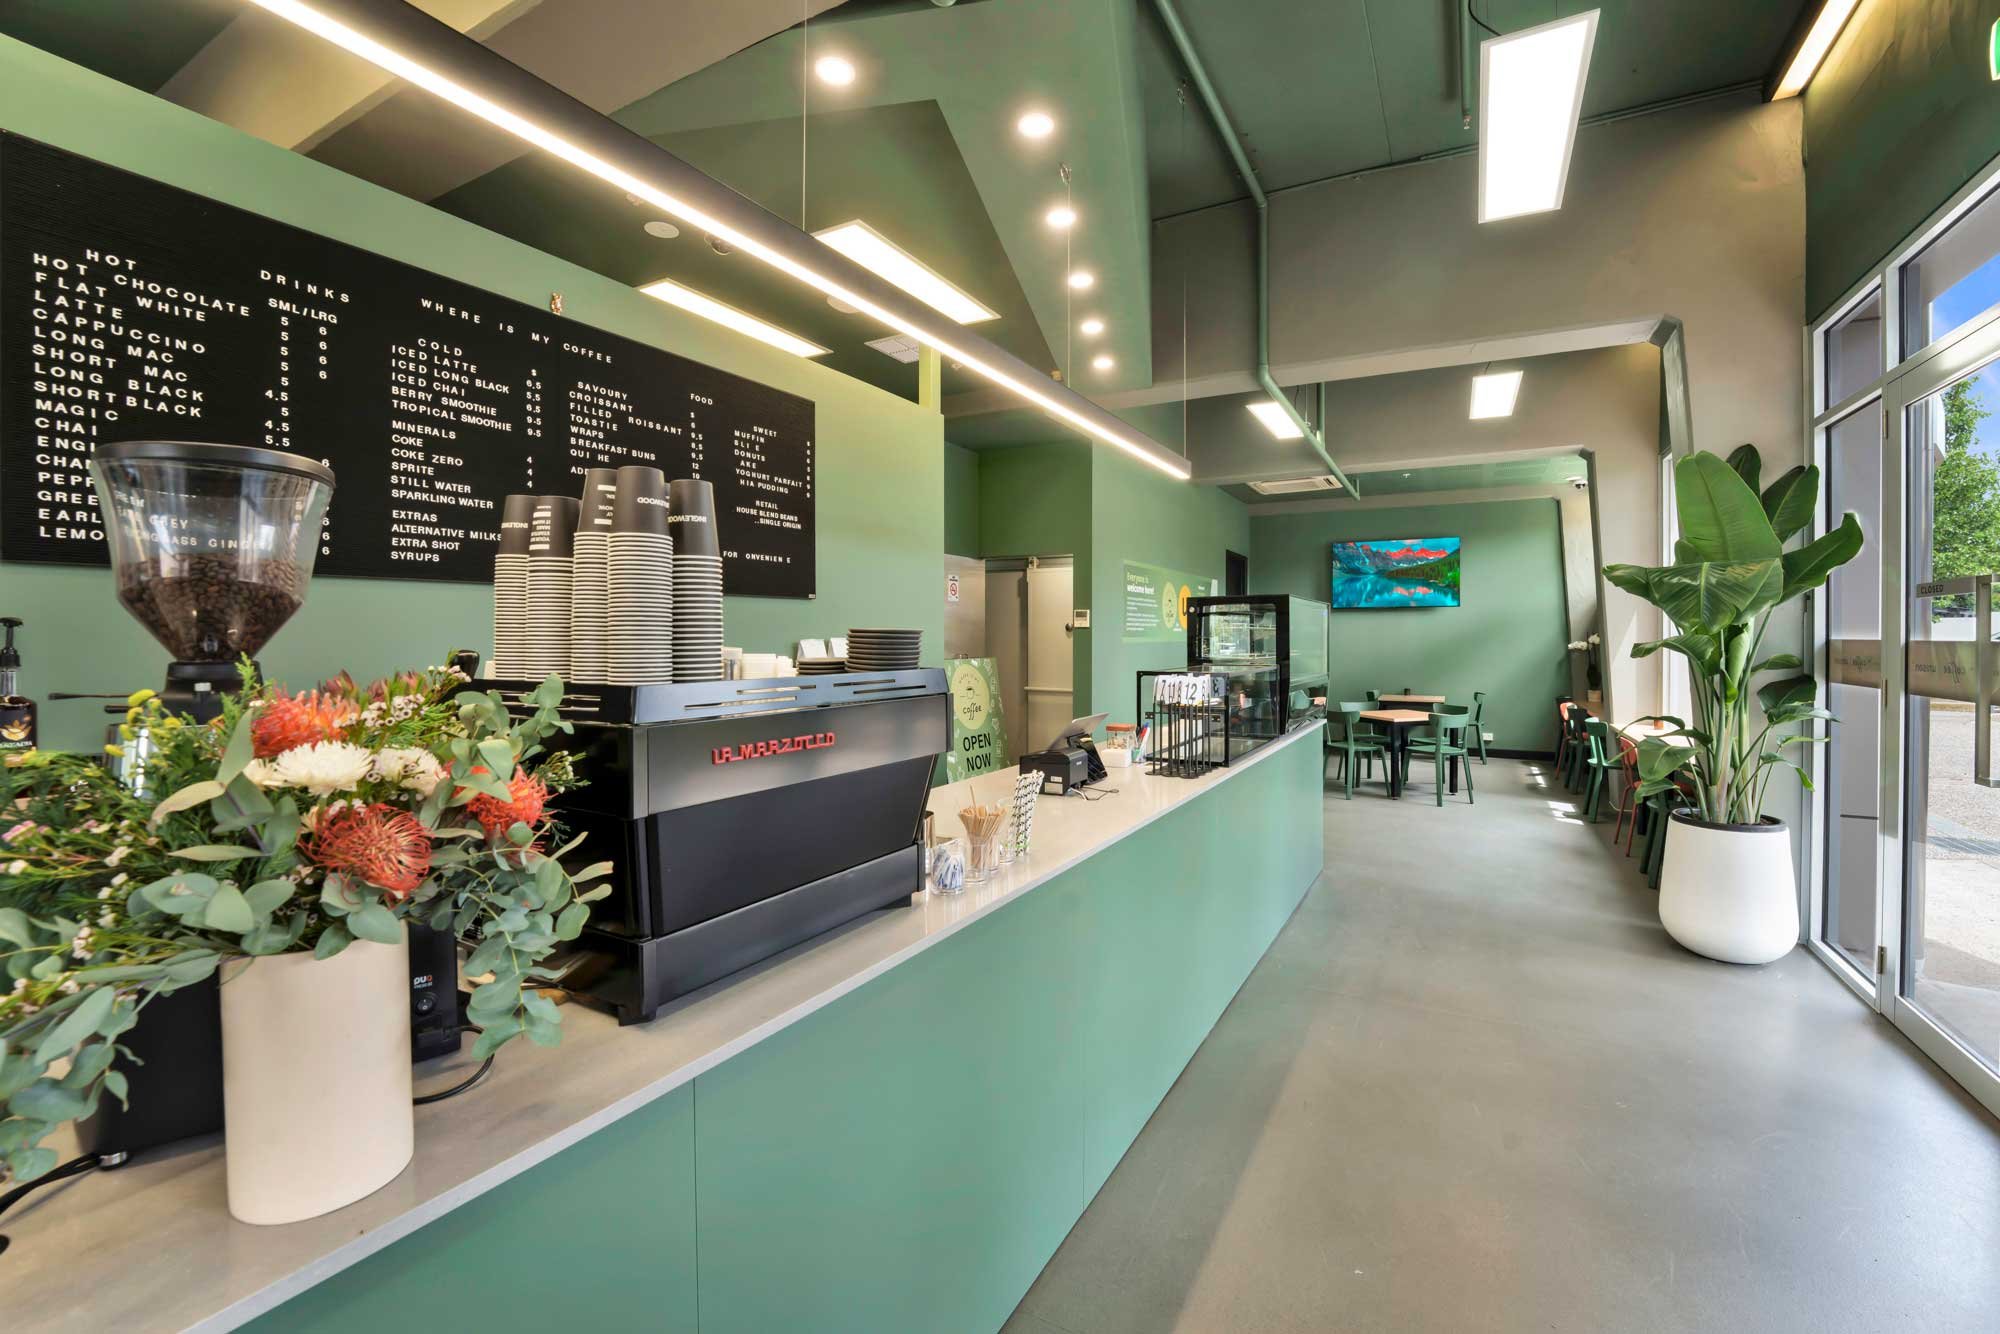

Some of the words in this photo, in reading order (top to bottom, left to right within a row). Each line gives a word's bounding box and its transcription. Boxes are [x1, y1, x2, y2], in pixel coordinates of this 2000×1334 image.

[86, 249, 136, 270] HOT
[33, 253, 88, 275] HOT
[114, 274, 249, 316] CHOCOLATE
[260, 270, 349, 303] DRINKS
[35, 272, 107, 297] FLAT
[136, 296, 205, 321] WHITE
[35, 290, 122, 319] LATTE
[268, 298, 337, 324] SML/LRG
[33, 308, 205, 353] CAPPUCCINO
[281, 316, 289, 326] 5
[319, 326, 327, 335] 6
[421, 298, 480, 323] WHERE
[499, 323, 514, 333] IS
[532, 332, 549, 344] MY
[563, 343, 611, 363] COFFEE
[35, 326, 104, 350] LONG
[128, 345, 173, 363] MAC
[281, 331, 289, 341] 5
[319, 341, 327, 350] 6
[418, 338, 462, 356] COLD
[32, 344, 116, 368] SHORT
[144, 365, 187, 382] MAC
[280, 346, 288, 356] 5
[319, 356, 327, 365] 6
[392, 345, 427, 360] ICED
[434, 355, 477, 373] LATTE
[281, 362, 289, 371] 5
[319, 370, 327, 379] 6
[392, 359, 427, 374] ICED
[434, 369, 469, 384] LONG
[475, 379, 509, 394] BLACK
[35, 362, 103, 384] LONG
[128, 379, 203, 402] BLACK
[281, 377, 289, 386] 5
[392, 372, 426, 387] ICED
[433, 382, 465, 396] CHAI
[526, 379, 541, 390] 6.5
[577, 381, 627, 400] SAVOURY
[34, 381, 116, 403] SHORT
[126, 396, 201, 418] BLACK
[265, 390, 288, 401] 4.5
[392, 386, 432, 402] BERRY
[441, 397, 497, 416] SMOOTHIE
[526, 391, 541, 401] 5.5
[569, 391, 633, 412] CROISSANT
[690, 393, 713, 405] FOOD
[36, 399, 118, 421] MAGIC
[281, 407, 289, 416] 5
[392, 399, 456, 420] TROPICAL
[461, 414, 511, 431] SMOOTHIE
[526, 404, 541, 413] 6.5
[35, 417, 97, 436] CHAI
[265, 420, 290, 432] 4.5
[526, 416, 541, 425] 9.5
[570, 402, 612, 418] FILLED
[628, 416, 682, 435] ROISSANT
[570, 414, 617, 431] TOASTIE
[392, 420, 456, 439] MINERALS
[527, 428, 541, 437] 9.5
[570, 425, 604, 439] WRAPS
[734, 430, 764, 443] MUFFIN
[753, 426, 777, 437] SWEET
[265, 435, 290, 447] 5.5
[392, 434, 423, 447] COKE
[570, 437, 627, 455] BREAKFAST
[632, 450, 656, 461] BUNS
[391, 448, 424, 461] COKE
[432, 454, 463, 466] ZERO
[526, 455, 533, 465] 4
[734, 449, 765, 462] DONUTS
[391, 461, 434, 476] SPRITE
[526, 467, 534, 477] 4
[692, 462, 699, 470] 12
[390, 475, 429, 488] STILL
[435, 481, 471, 493] WATER
[526, 480, 534, 489] 4
[692, 472, 700, 480] 10
[736, 468, 770, 481] YOGHURT
[774, 476, 802, 488] PARFAIT
[758, 482, 788, 494] PUDDING
[391, 489, 455, 504] SPARKLING
[458, 497, 493, 509] WATER
[755, 500, 778, 510] RETAIL
[38, 508, 102, 523] EARL
[392, 510, 437, 522] EXTRAS
[321, 531, 330, 541] 6
[391, 524, 464, 538] ALTERNATIVE
[470, 530, 502, 541] MILKS
[322, 546, 330, 555] 6
[392, 537, 428, 548] EXTRA
[431, 540, 460, 550] SHOT
[391, 551, 440, 562] SYRUPS
[1920, 583, 1944, 595] CLOSED
[1185, 682, 1198, 700] 12
[962, 702, 982, 721] coffee
[962, 732, 992, 752] OPEN
[966, 752, 992, 772] NOW
